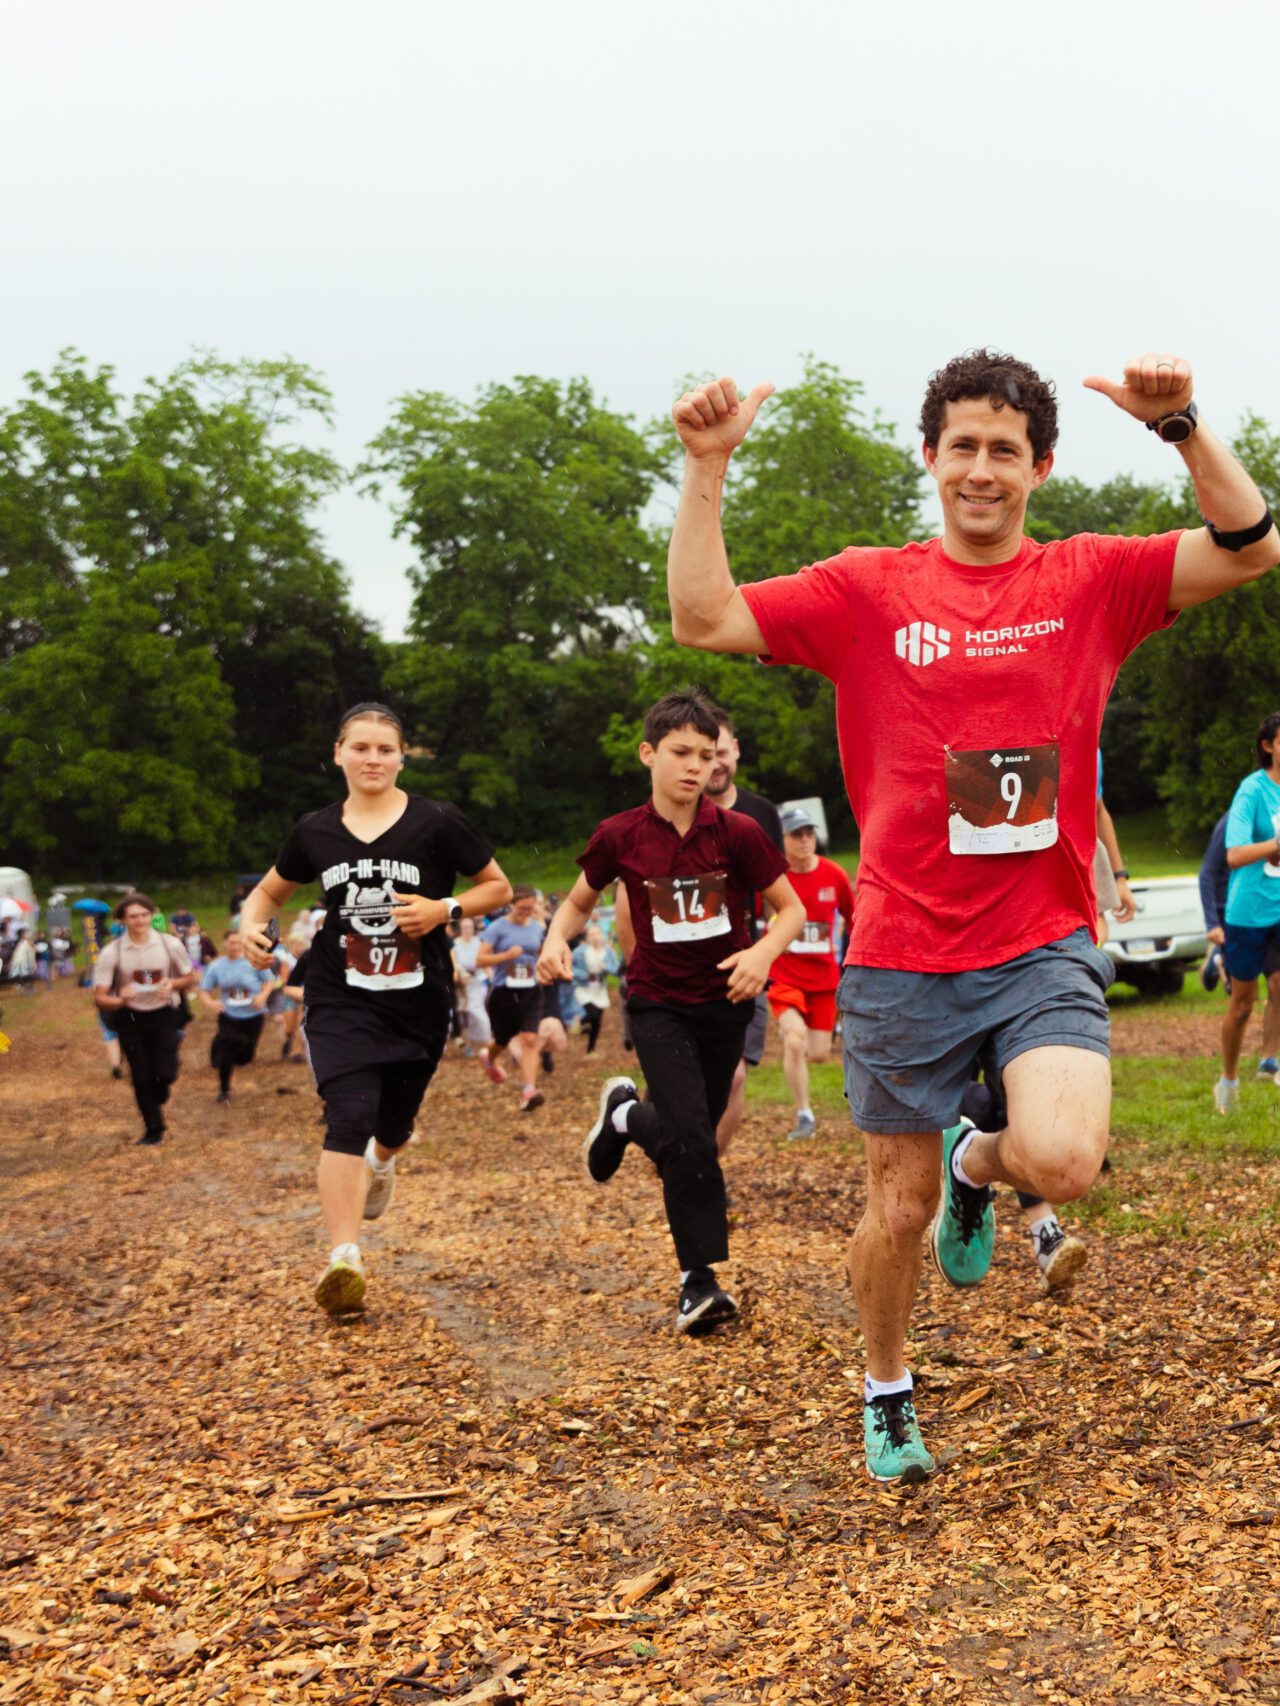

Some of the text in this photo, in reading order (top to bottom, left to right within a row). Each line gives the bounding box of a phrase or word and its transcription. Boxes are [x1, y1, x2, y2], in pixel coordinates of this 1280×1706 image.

[965, 617, 1065, 643] HORIZON
[965, 643, 1028, 657] SIGNAL
[1000, 772, 1022, 820] 9
[321, 858, 421, 891] BIRD-IN-HAND
[673, 889, 705, 921] 14
[369, 947, 398, 973] 97
